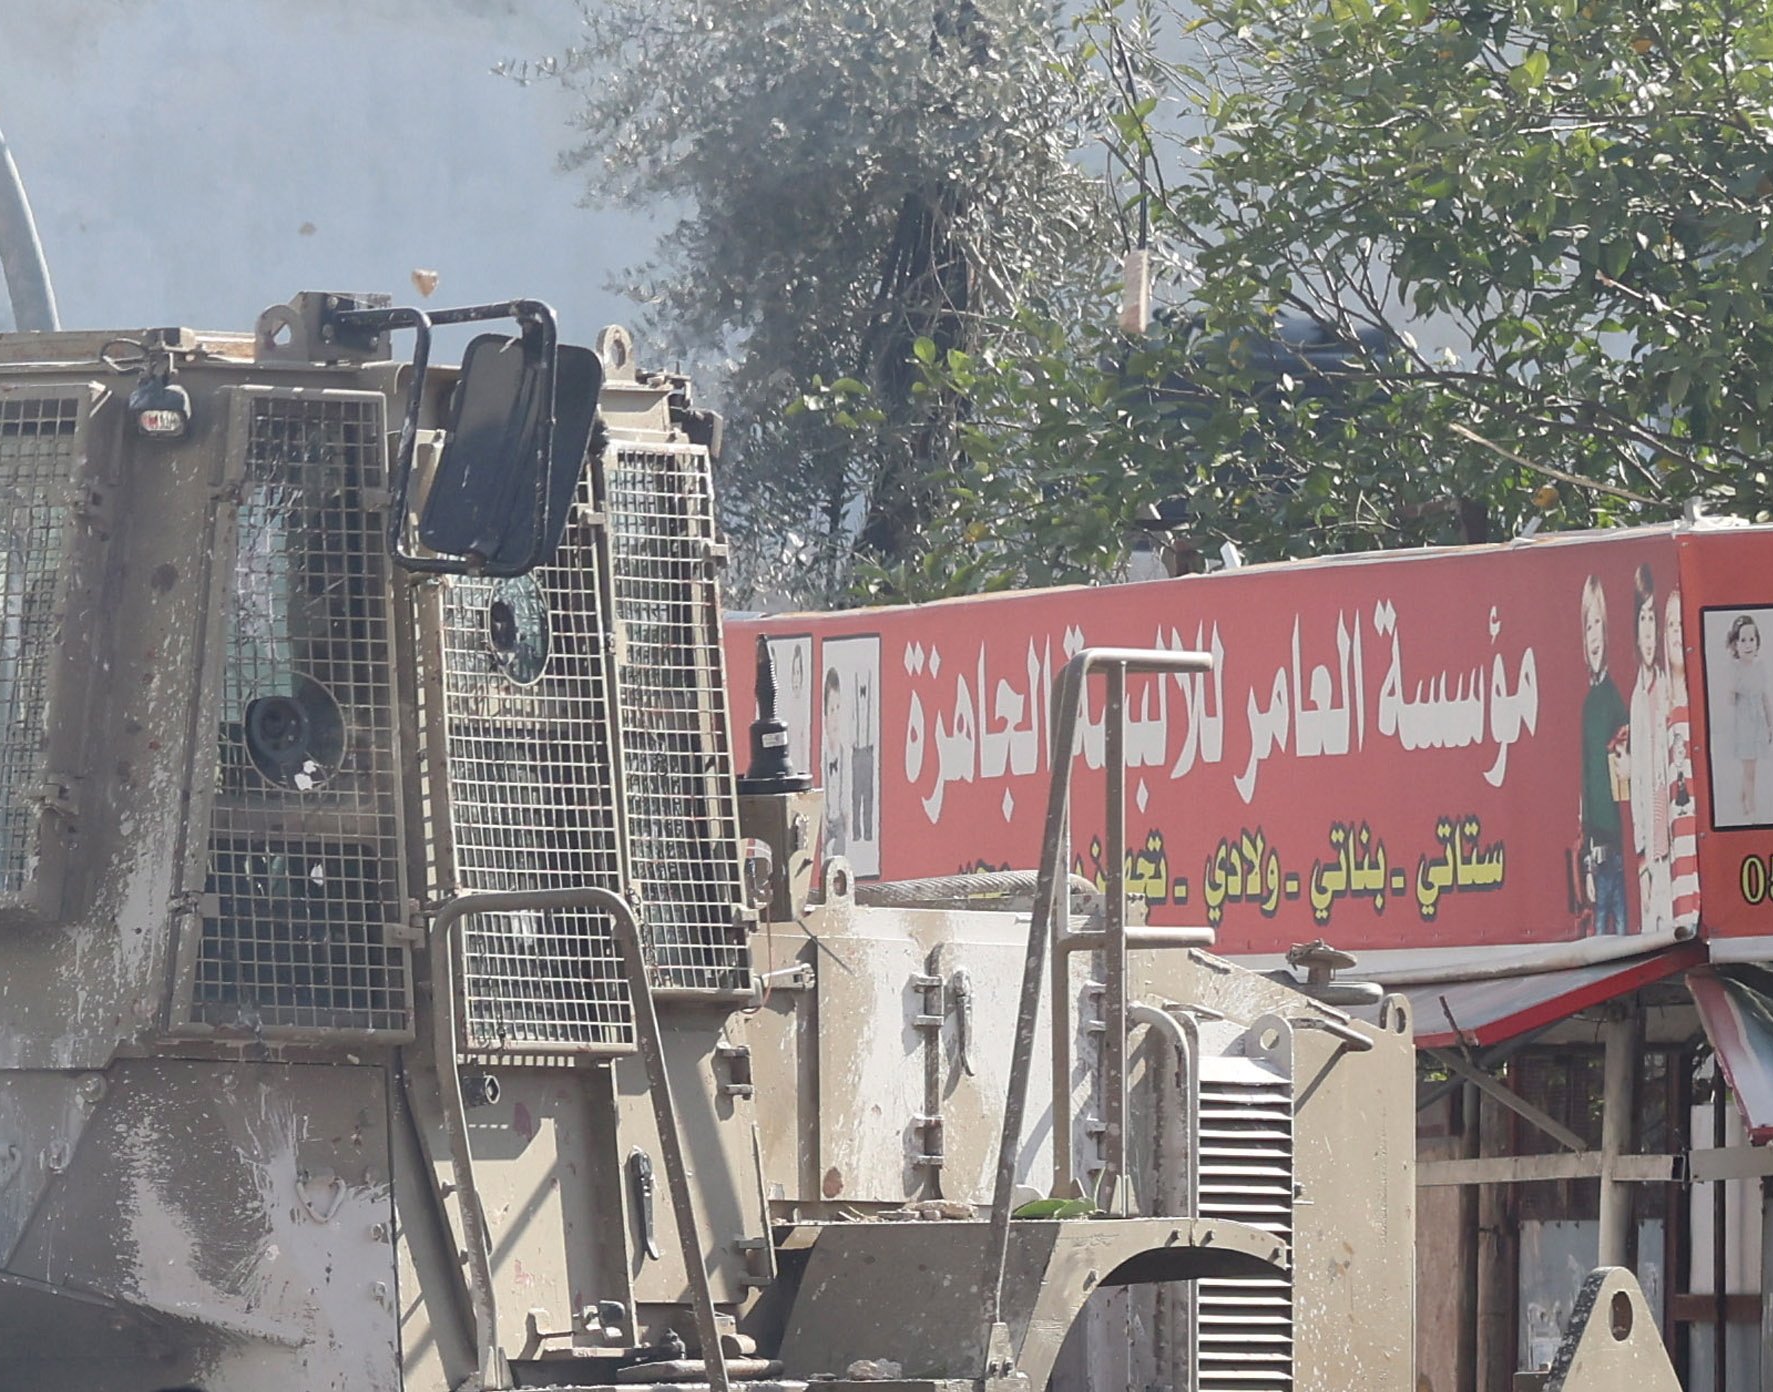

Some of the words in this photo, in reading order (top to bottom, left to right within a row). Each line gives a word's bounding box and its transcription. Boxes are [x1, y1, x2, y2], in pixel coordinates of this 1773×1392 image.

[903, 633, 1051, 824] الجاهزة
[1234, 607, 1364, 804] العامر
[1374, 597, 1538, 788] مؤسسة
[1204, 825, 1280, 926] ولادي
[1309, 820, 1386, 924] بناتي
[1414, 815, 1507, 922] ستاتي
